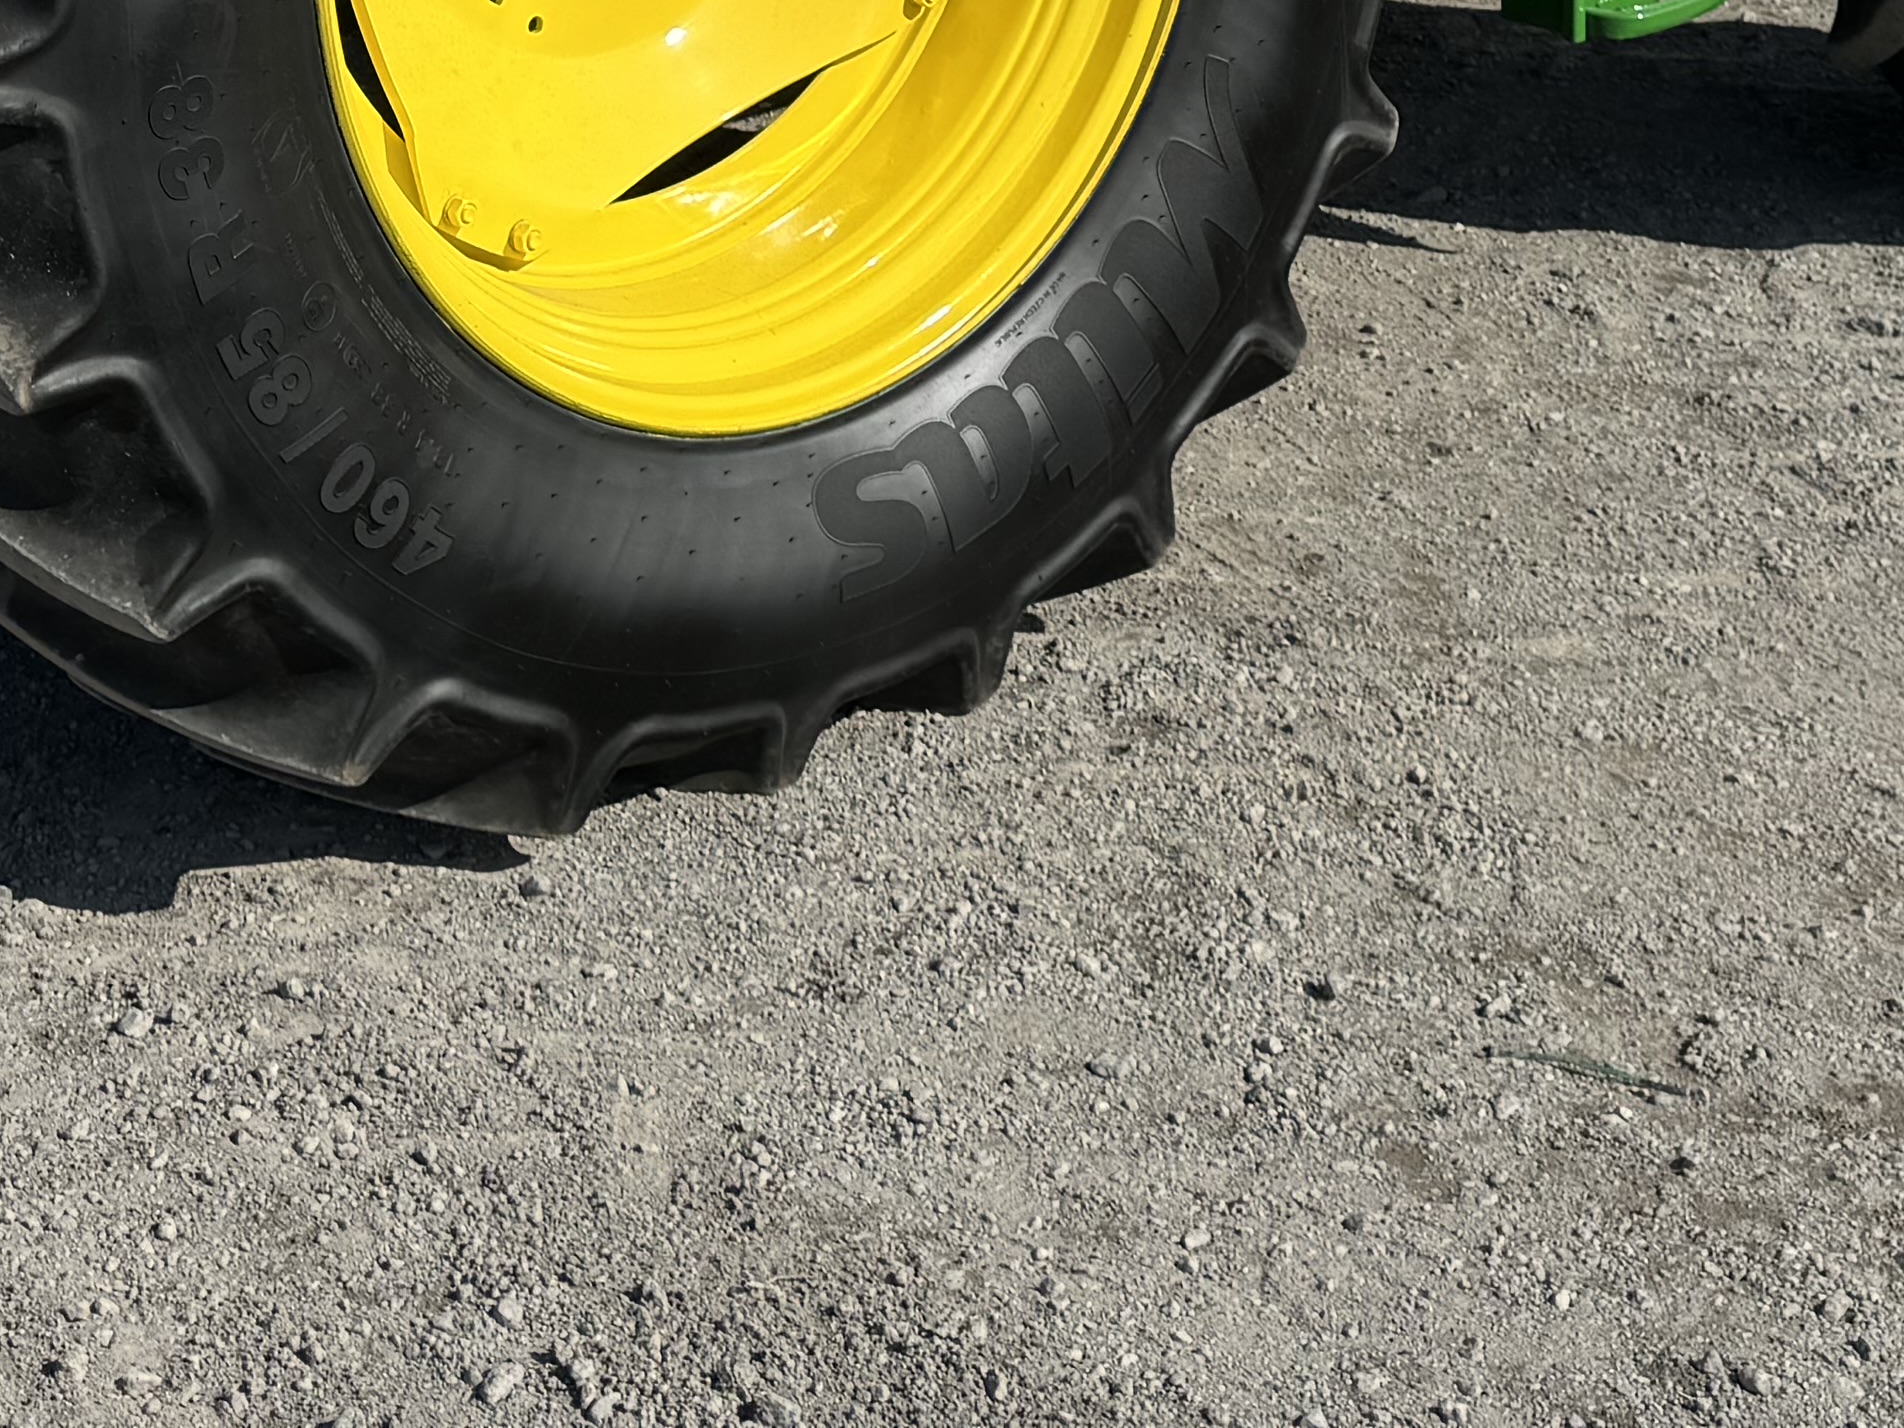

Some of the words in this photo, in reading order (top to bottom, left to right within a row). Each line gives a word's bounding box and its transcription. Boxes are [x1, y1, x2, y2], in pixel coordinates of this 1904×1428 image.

[145, 74, 225, 202] 38
[185, 205, 256, 308] R
[810, 54, 1268, 604] Mitas
